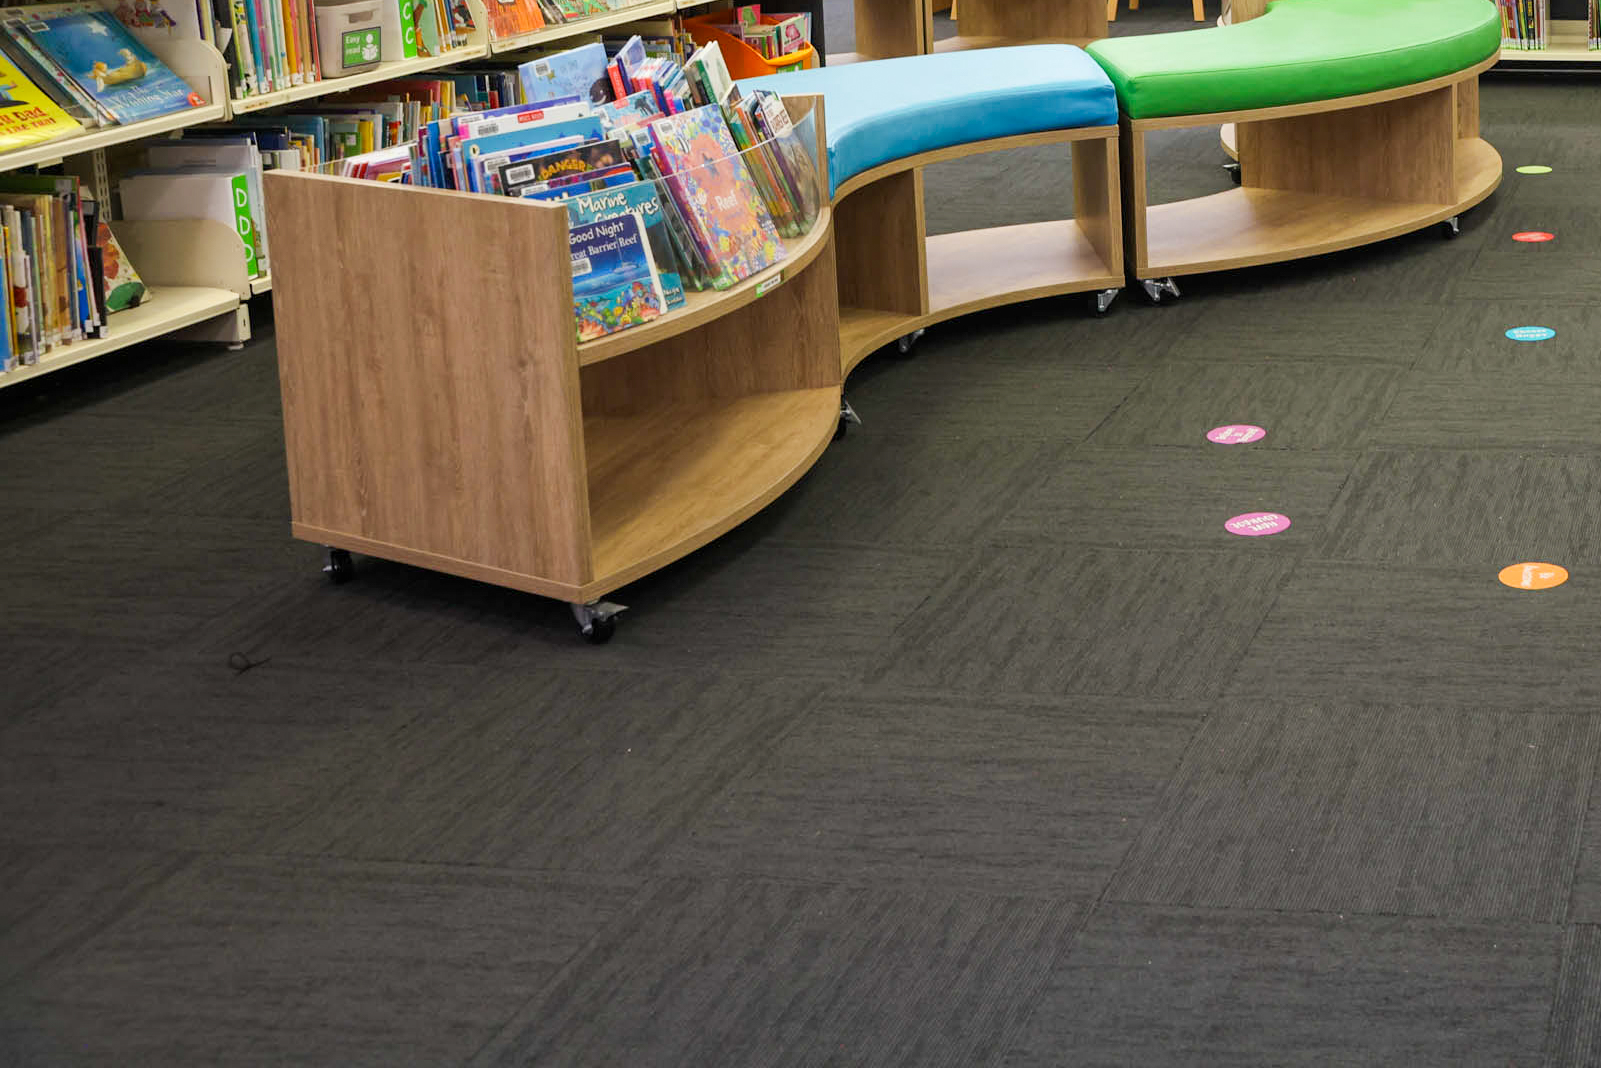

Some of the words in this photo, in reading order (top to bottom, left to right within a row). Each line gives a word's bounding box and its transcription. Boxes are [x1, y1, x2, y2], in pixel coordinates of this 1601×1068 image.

[346, 35, 360, 44] Easy
[346, 45, 360, 54] read
[13, 107, 48, 121] Dad
[540, 158, 586, 179] DANGER
[577, 192, 627, 214] Marine
[715, 190, 738, 211] Reef
[569, 229, 594, 245] Good
[595, 221, 624, 238] Night
[571, 250, 587, 261] reat
[588, 240, 617, 256] Barrier
[619, 233, 638, 248] Reef
